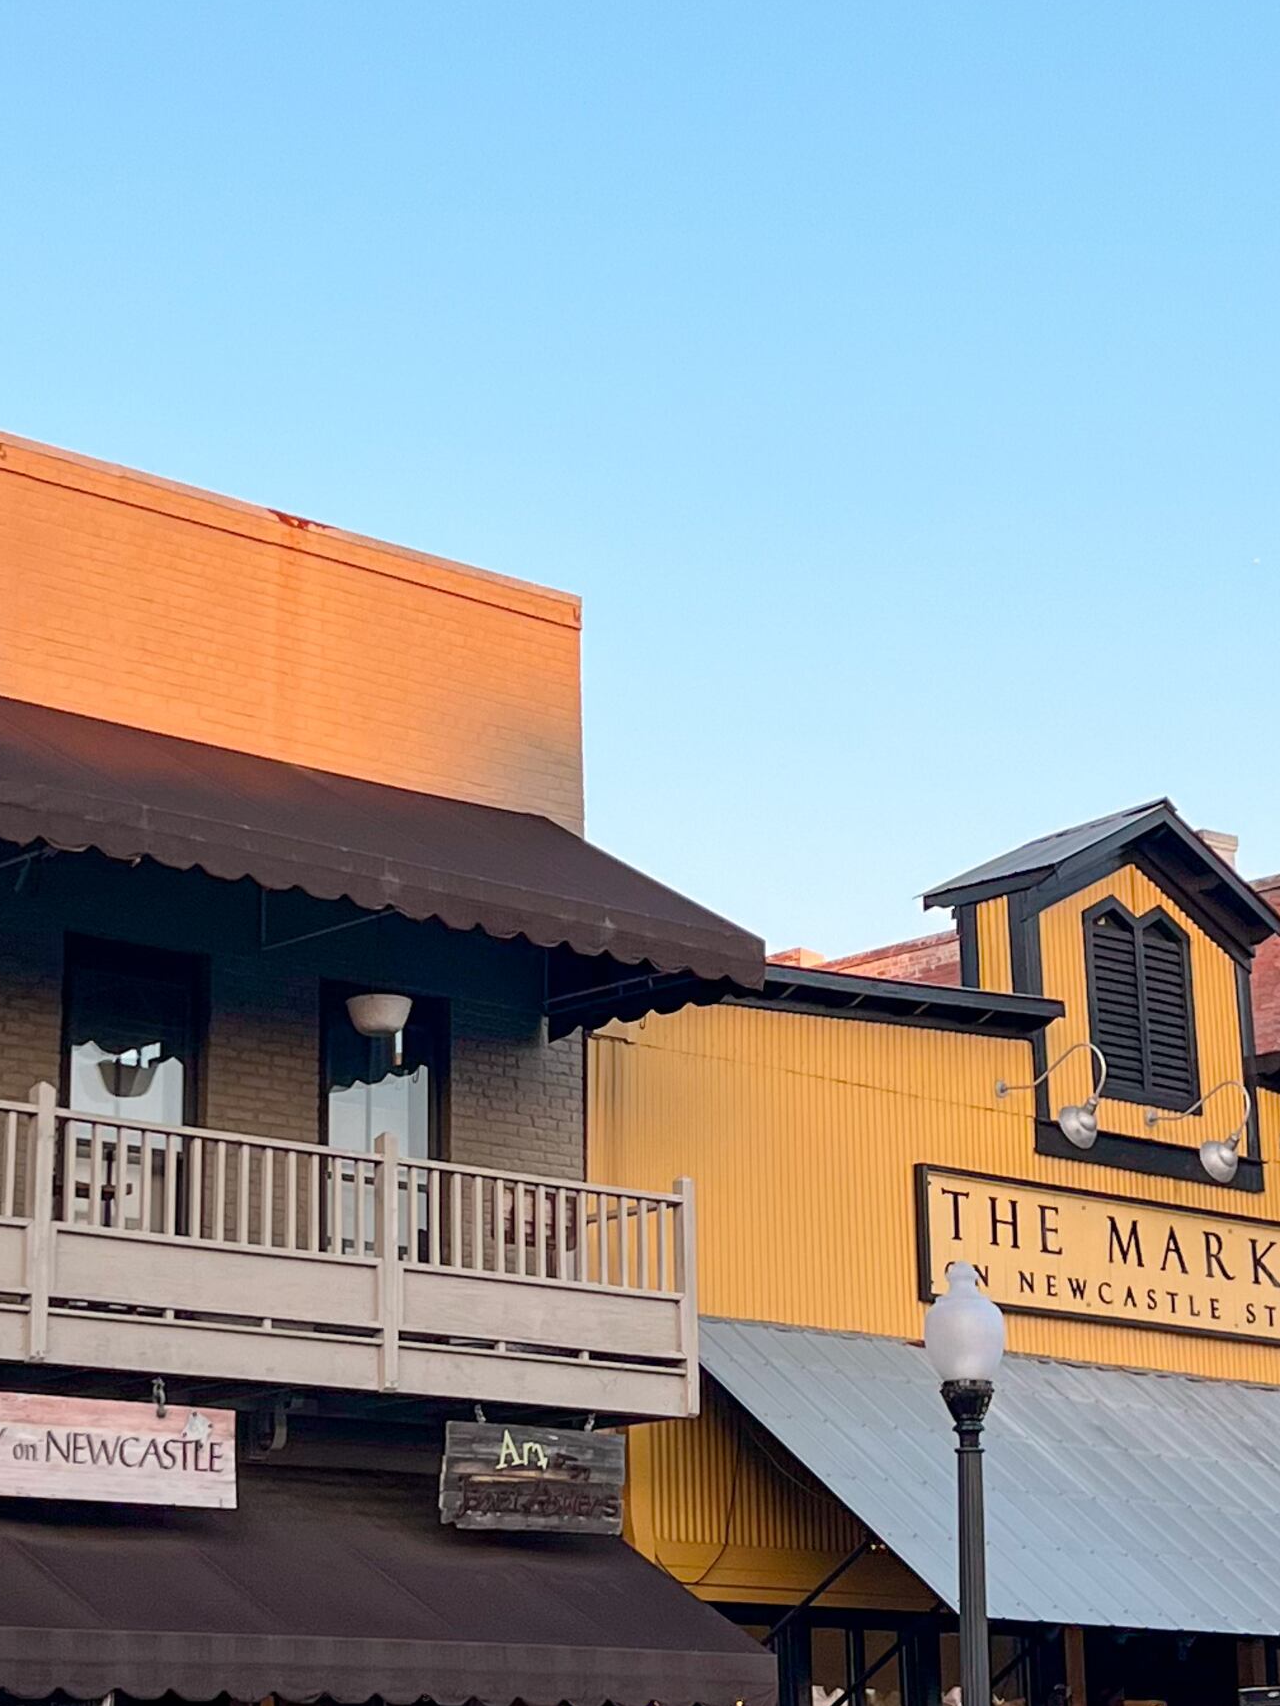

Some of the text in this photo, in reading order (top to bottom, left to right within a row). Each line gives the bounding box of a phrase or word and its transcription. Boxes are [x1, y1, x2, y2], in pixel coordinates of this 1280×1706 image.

[941, 1187, 1063, 1256] THE
[1018, 1270, 1221, 1320] NEWCASTLE
[12, 1439, 39, 1462] on
[45, 1430, 224, 1473] NEWCASTLE
